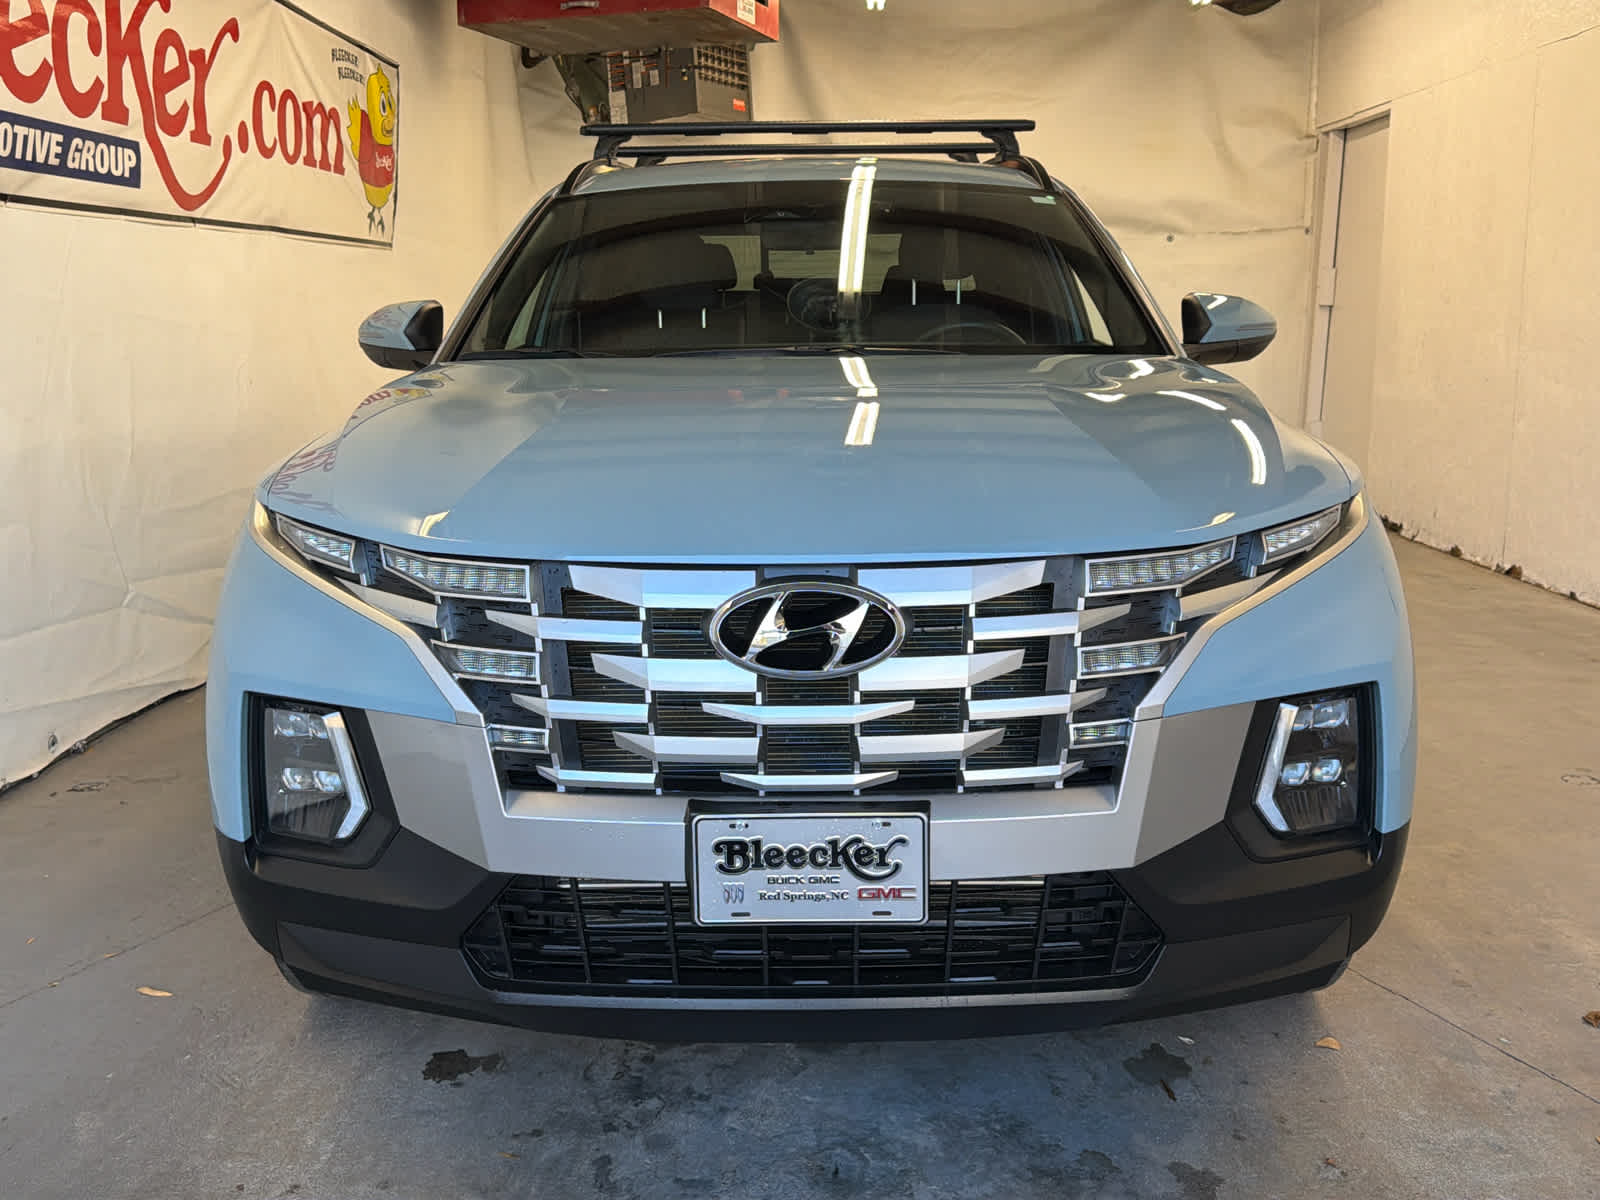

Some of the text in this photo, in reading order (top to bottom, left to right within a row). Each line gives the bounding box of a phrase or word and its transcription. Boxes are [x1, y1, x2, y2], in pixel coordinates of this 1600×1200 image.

[0, 121, 137, 178] OTIVE GROUP
[767, 875, 841, 885] BUICK GMC
[758, 891, 849, 902] Red Springs, NC
[857, 886, 917, 900] GMC
